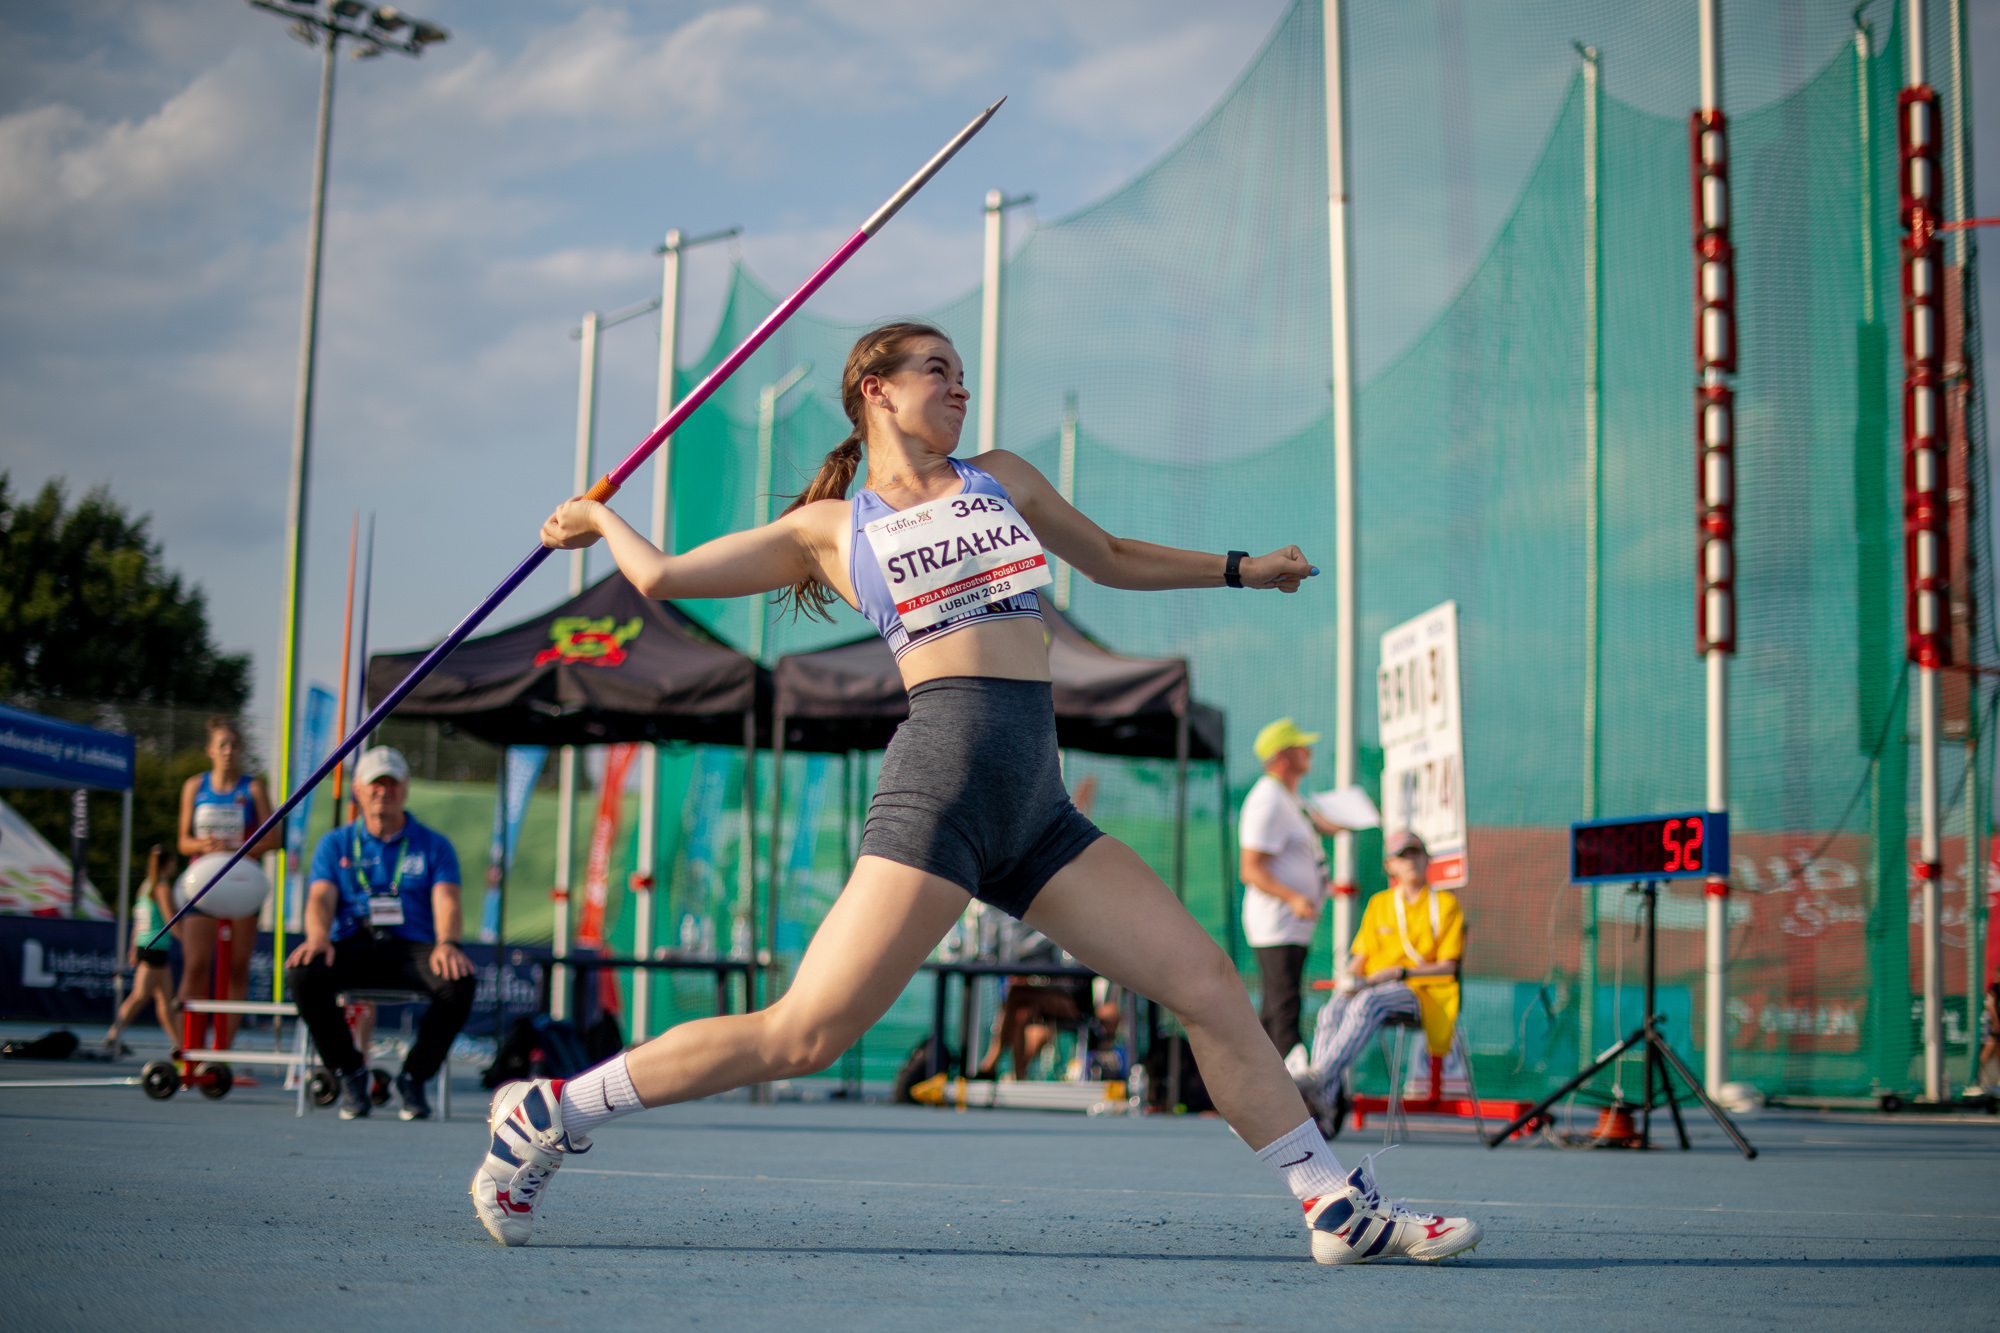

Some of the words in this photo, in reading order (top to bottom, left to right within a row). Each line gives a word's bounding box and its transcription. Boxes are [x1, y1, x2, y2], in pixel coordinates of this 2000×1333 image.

[951, 497, 1004, 518] 345
[887, 524, 1031, 584] STRZAŁKA
[906, 600, 920, 611] 77.
[920, 593, 941, 606] PZLA
[941, 574, 992, 597] Mistrzostwa
[992, 564, 1018, 579] Polski
[1018, 558, 1036, 570] U20
[939, 591, 980, 614] LUBLIN
[981, 580, 1011, 598] 2023
[1008, 592, 1040, 611] PUMA
[1662, 816, 1704, 873] 52
